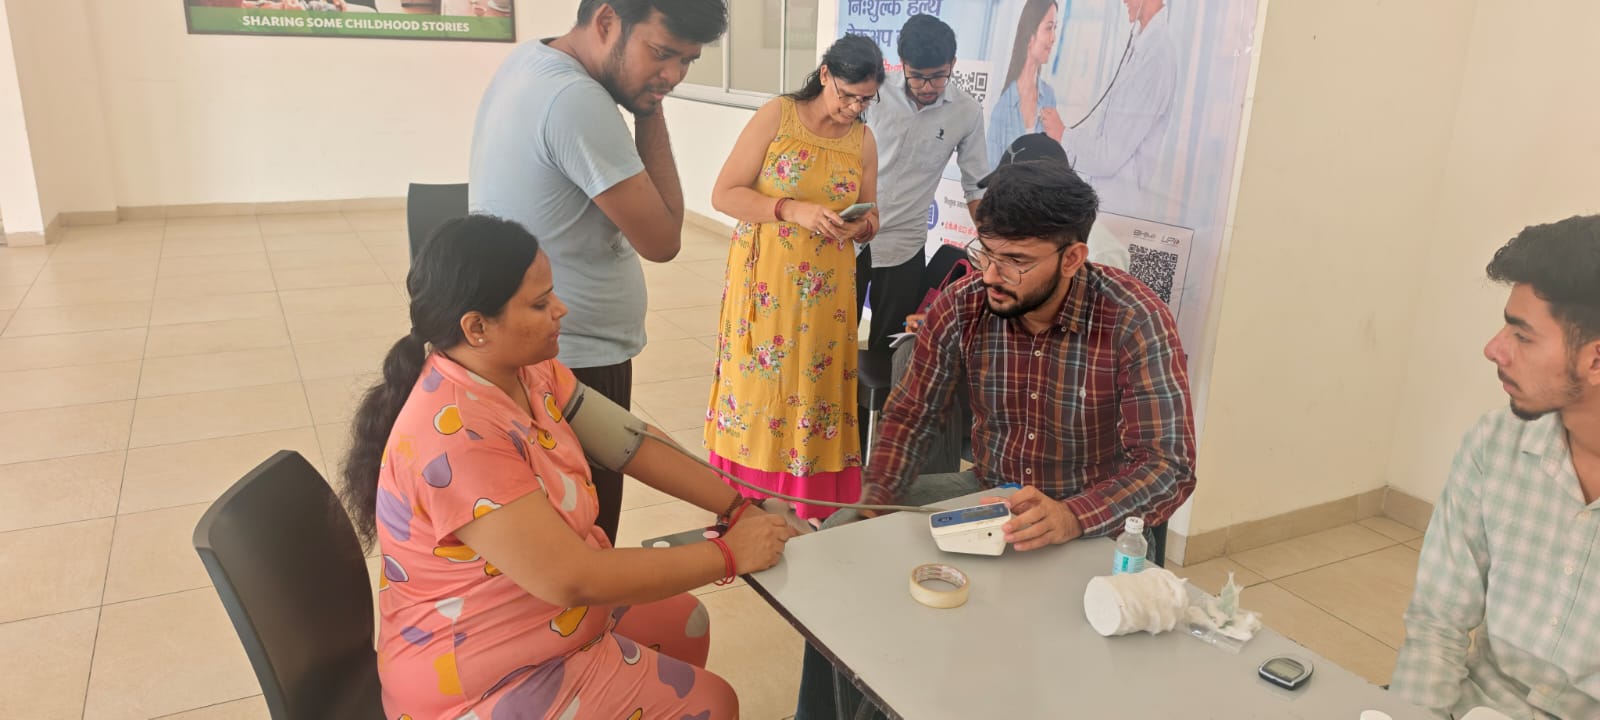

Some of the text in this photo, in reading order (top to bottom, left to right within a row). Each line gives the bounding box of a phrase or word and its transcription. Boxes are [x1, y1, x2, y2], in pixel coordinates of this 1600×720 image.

[242, 15, 471, 32] SHARING SOME CHILDHOOD STORIES
